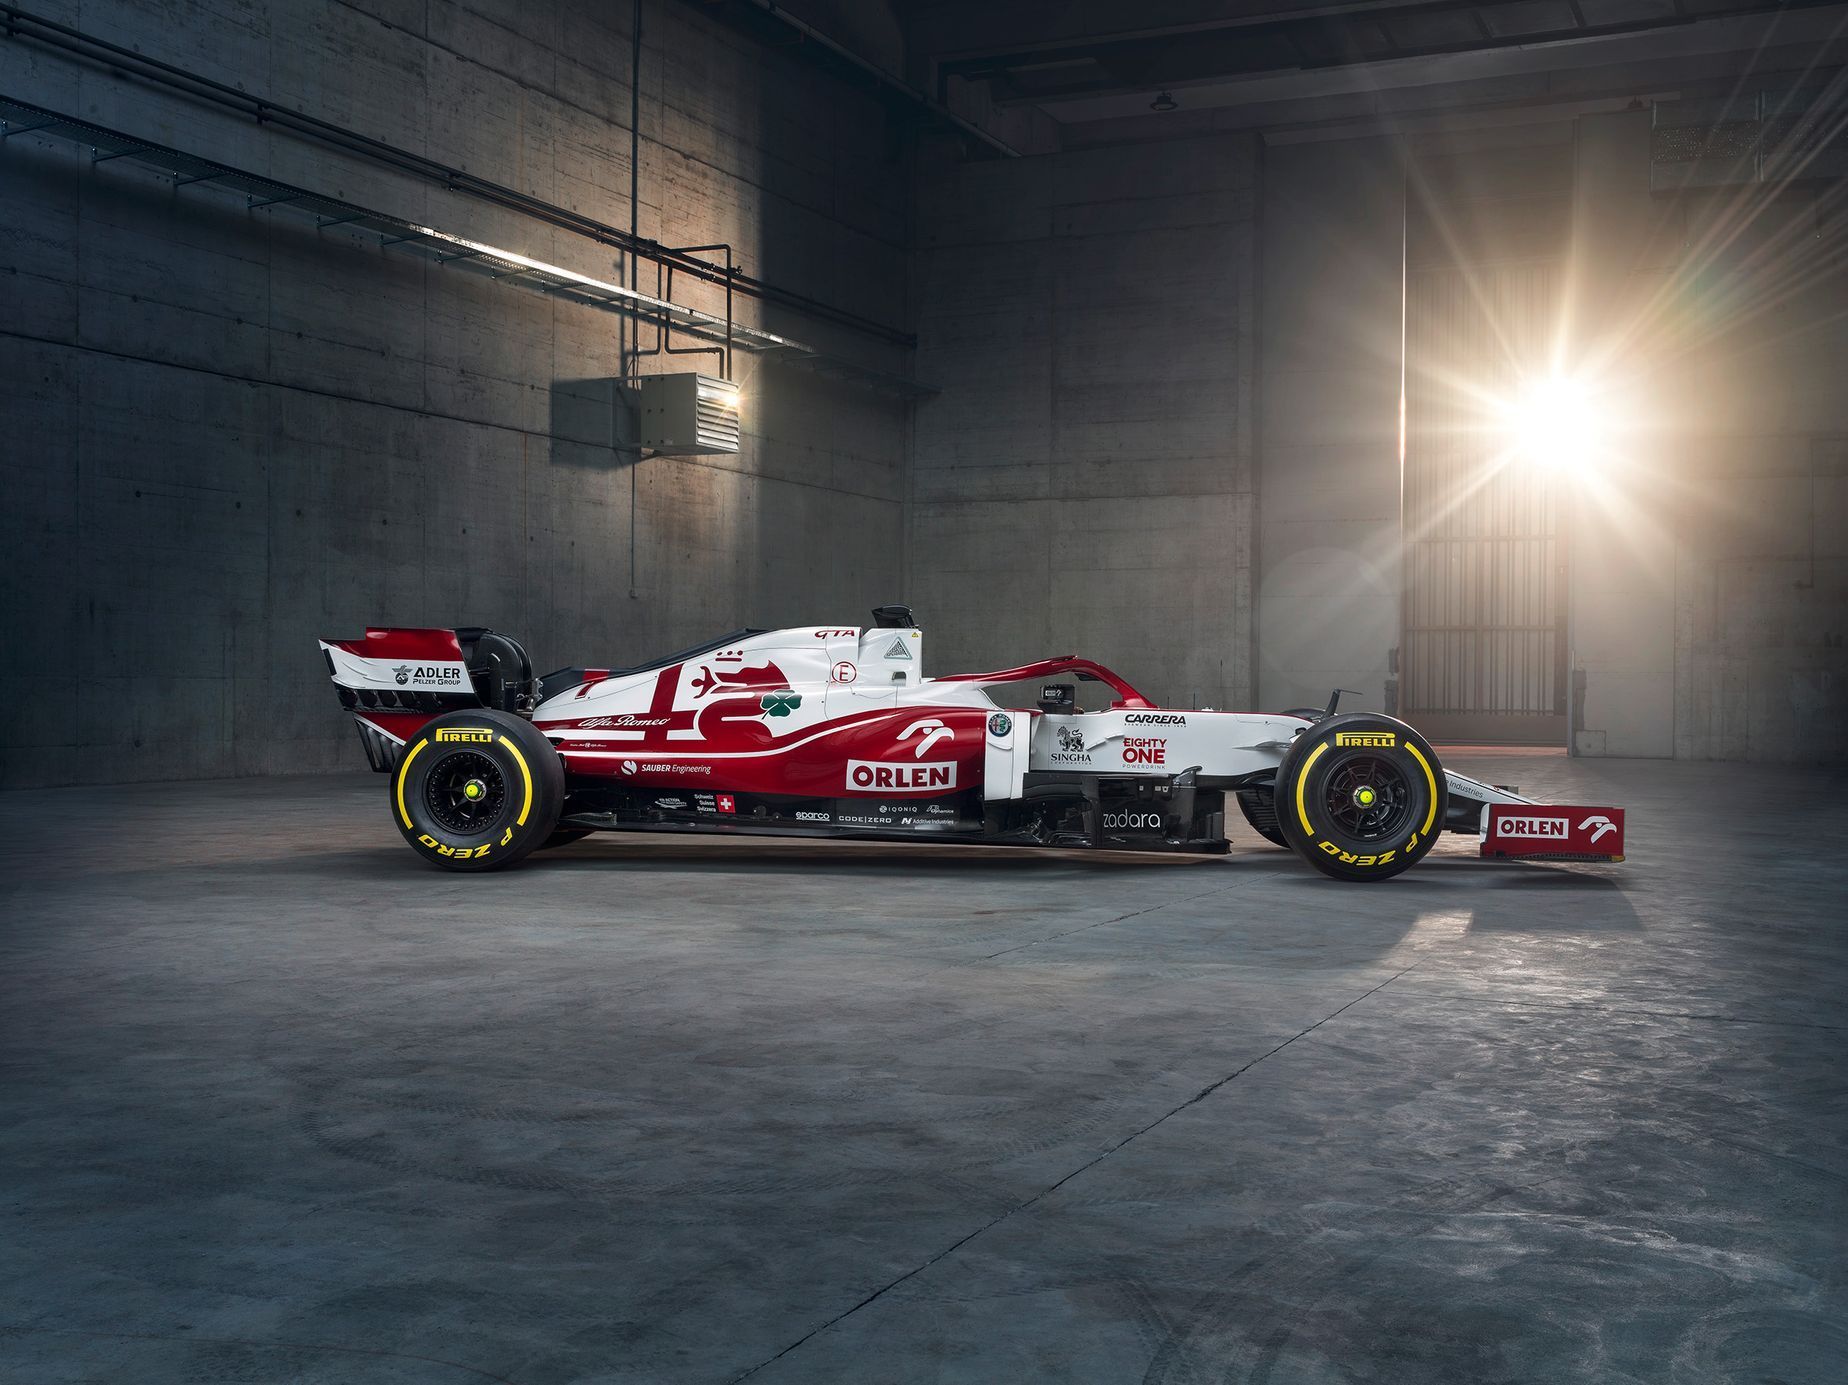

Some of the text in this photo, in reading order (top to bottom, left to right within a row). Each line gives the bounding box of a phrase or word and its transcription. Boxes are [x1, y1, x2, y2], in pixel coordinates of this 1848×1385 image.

[815, 630, 855, 639] GTA
[413, 667, 461, 679] ADLER
[839, 664, 849, 681] E
[577, 714, 671, 730] Alfa Romeo
[1124, 714, 1187, 725] CARRERA
[435, 728, 493, 743] PIRELLI
[1123, 737, 1168, 748] EIGHTY
[1335, 732, 1396, 747] PIRELLI
[1050, 753, 1092, 762] SINGHA
[1122, 747, 1166, 765] ONE
[641, 764, 712, 775] SAUBER Engineering
[852, 765, 950, 788] ORLEN
[1449, 780, 1484, 799] Industries
[795, 811, 830, 822] sparco
[1102, 808, 1161, 828] zadara
[1500, 819, 1564, 836] ORLEN
[417, 826, 513, 859] P ZERO
[1317, 832, 1418, 866] P ZERO
